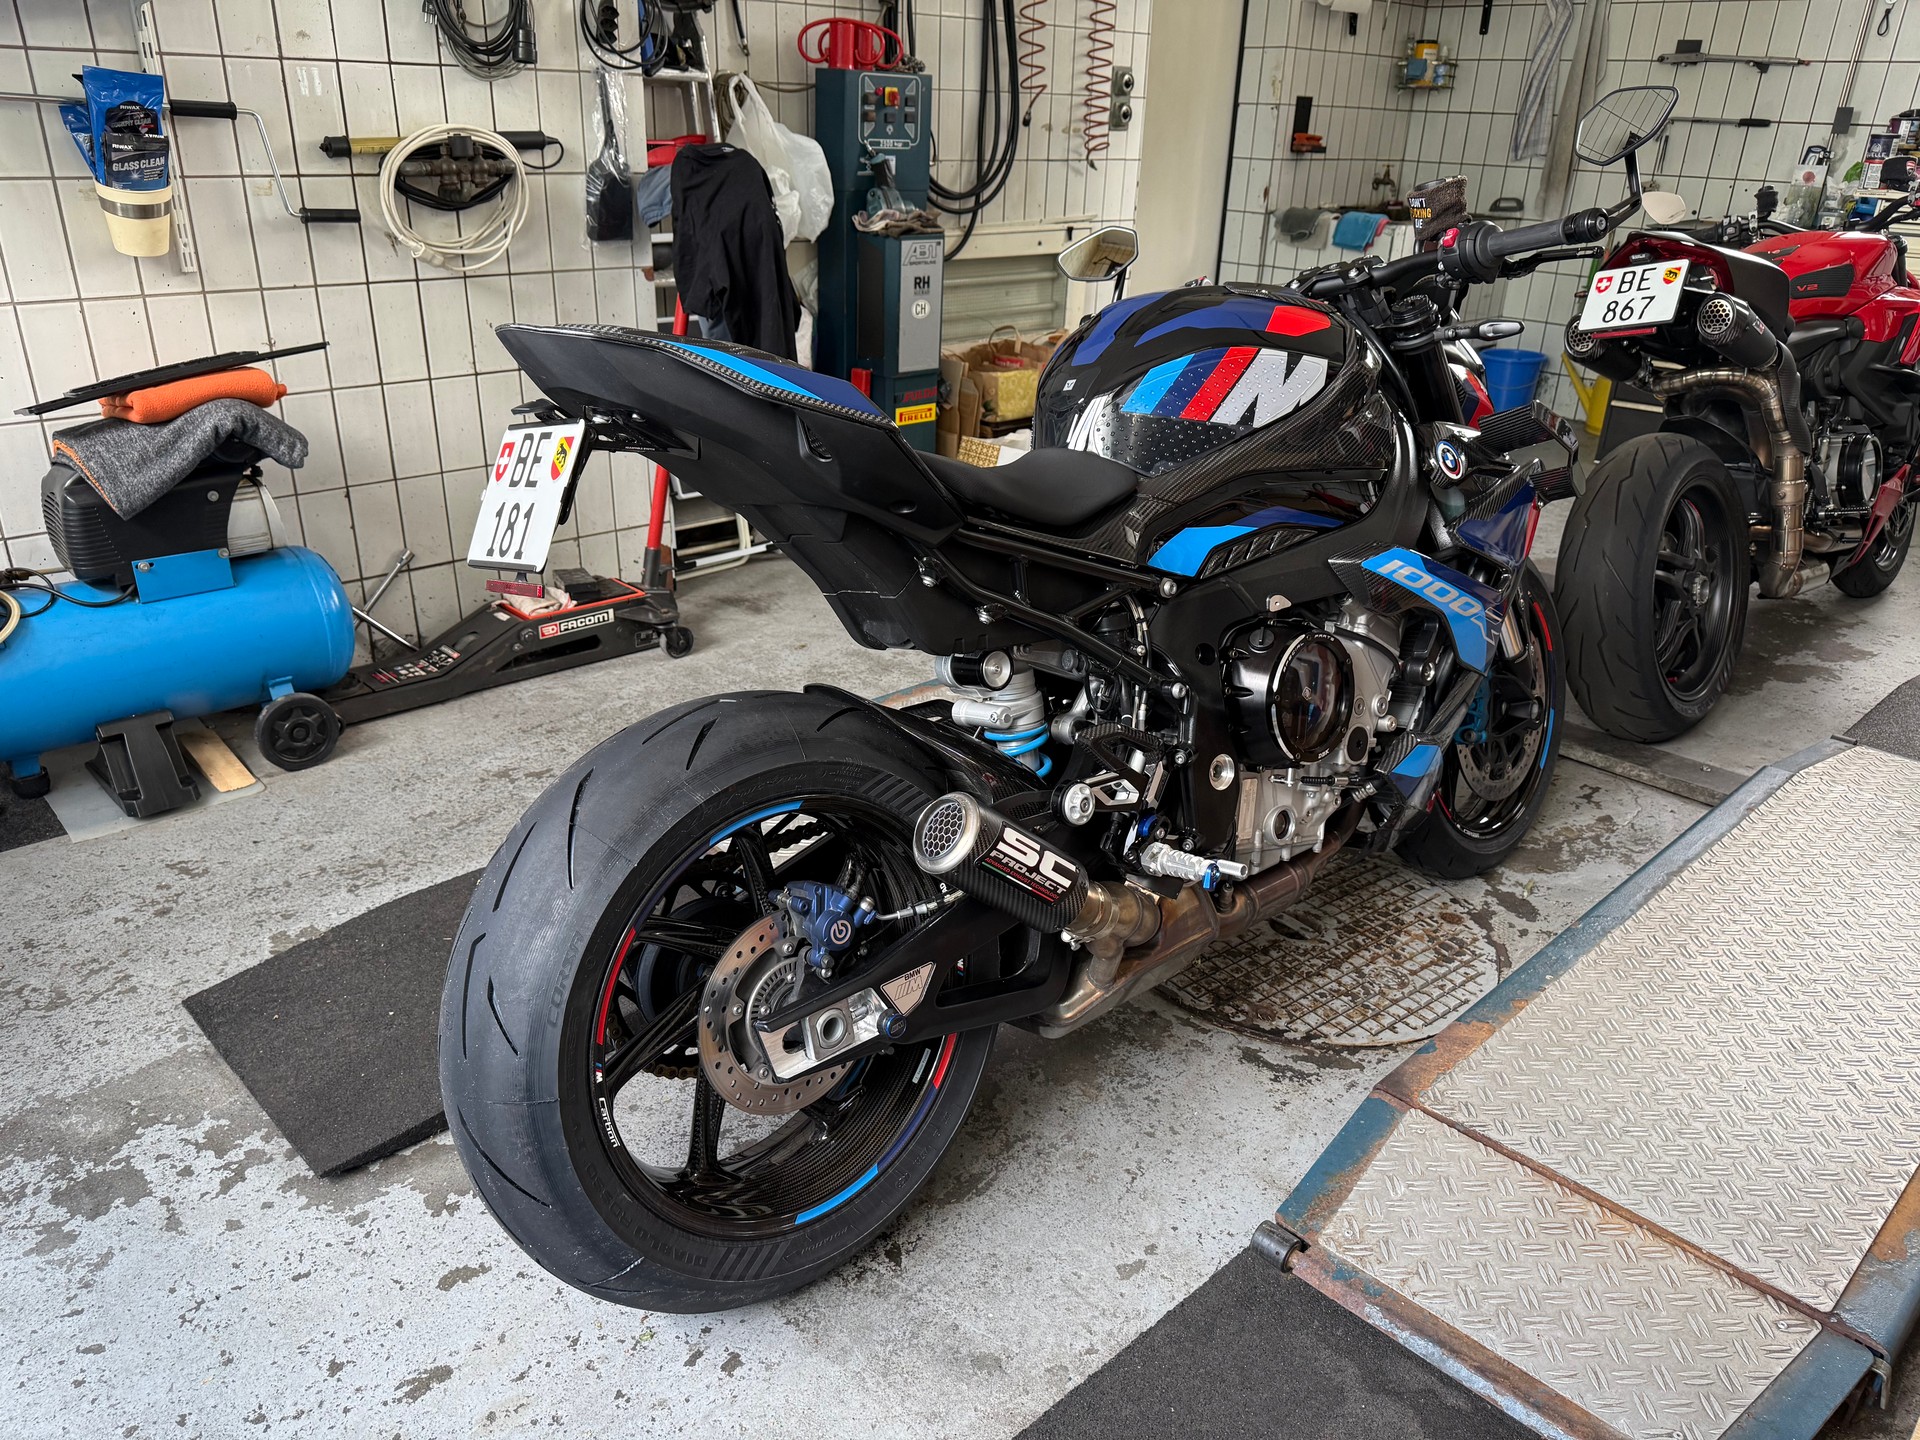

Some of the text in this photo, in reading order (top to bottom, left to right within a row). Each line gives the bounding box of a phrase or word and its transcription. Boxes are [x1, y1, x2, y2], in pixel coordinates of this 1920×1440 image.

[112, 156, 165, 171] GLASS CLEAN
[903, 242, 938, 266] ABT
[914, 276, 930, 289] RH
[1617, 267, 1657, 294] BE
[1796, 283, 1819, 291] V2
[915, 304, 926, 315] CH
[1602, 295, 1656, 323] 867
[899, 408, 932, 422] PIRELLI
[508, 432, 553, 488] BE
[486, 501, 535, 560] 181
[560, 612, 609, 632] FACOM
[996, 827, 1076, 888] SC
[984, 857, 1060, 900] ADVANCED EXHAUST TECHNOLOGY
[989, 849, 1067, 894] PROJECT
[904, 968, 921, 981] BMW
[599, 1097, 620, 1148] Carbon
